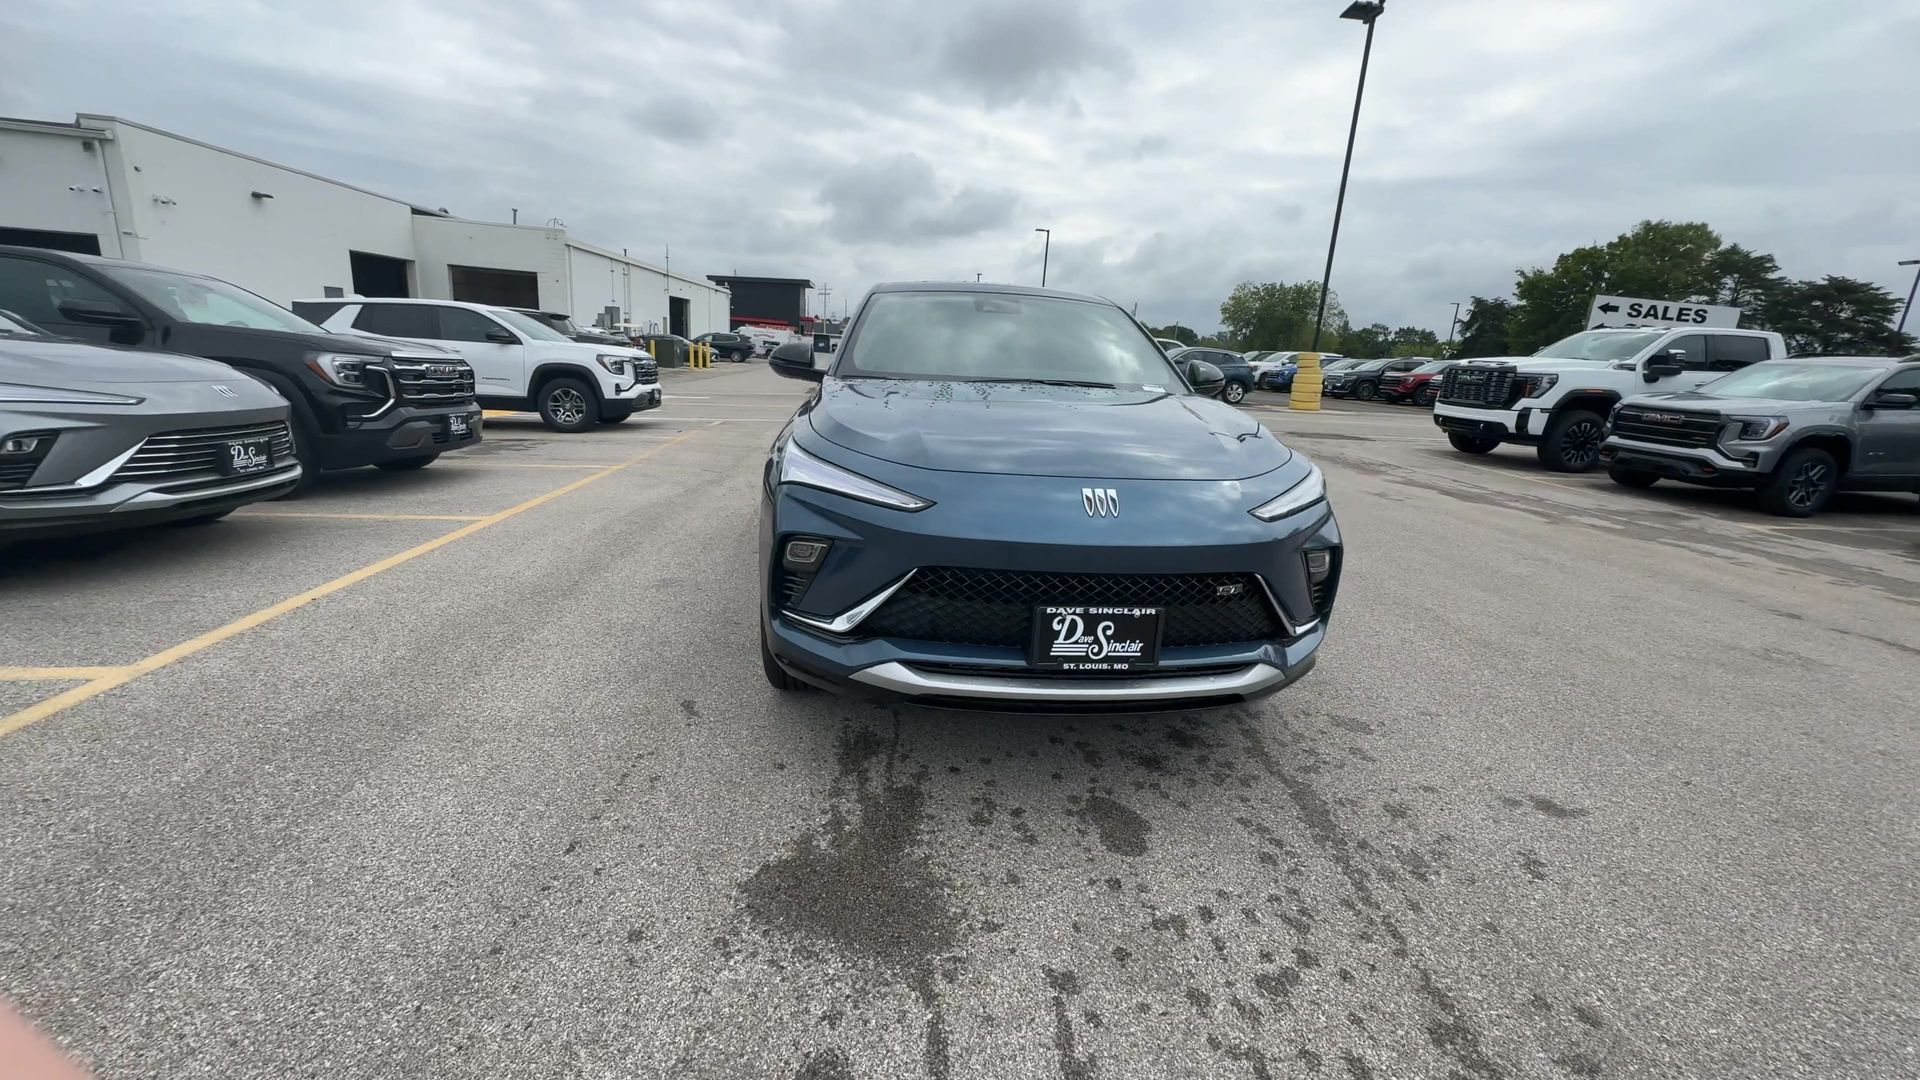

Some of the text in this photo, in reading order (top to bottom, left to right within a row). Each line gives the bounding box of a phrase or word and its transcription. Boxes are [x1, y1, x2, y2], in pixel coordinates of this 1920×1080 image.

[1627, 302, 1708, 324] SALES
[1046, 607, 1156, 615] DAVE SINCLAIR
[1052, 614, 1144, 660] Dave Sinclair
